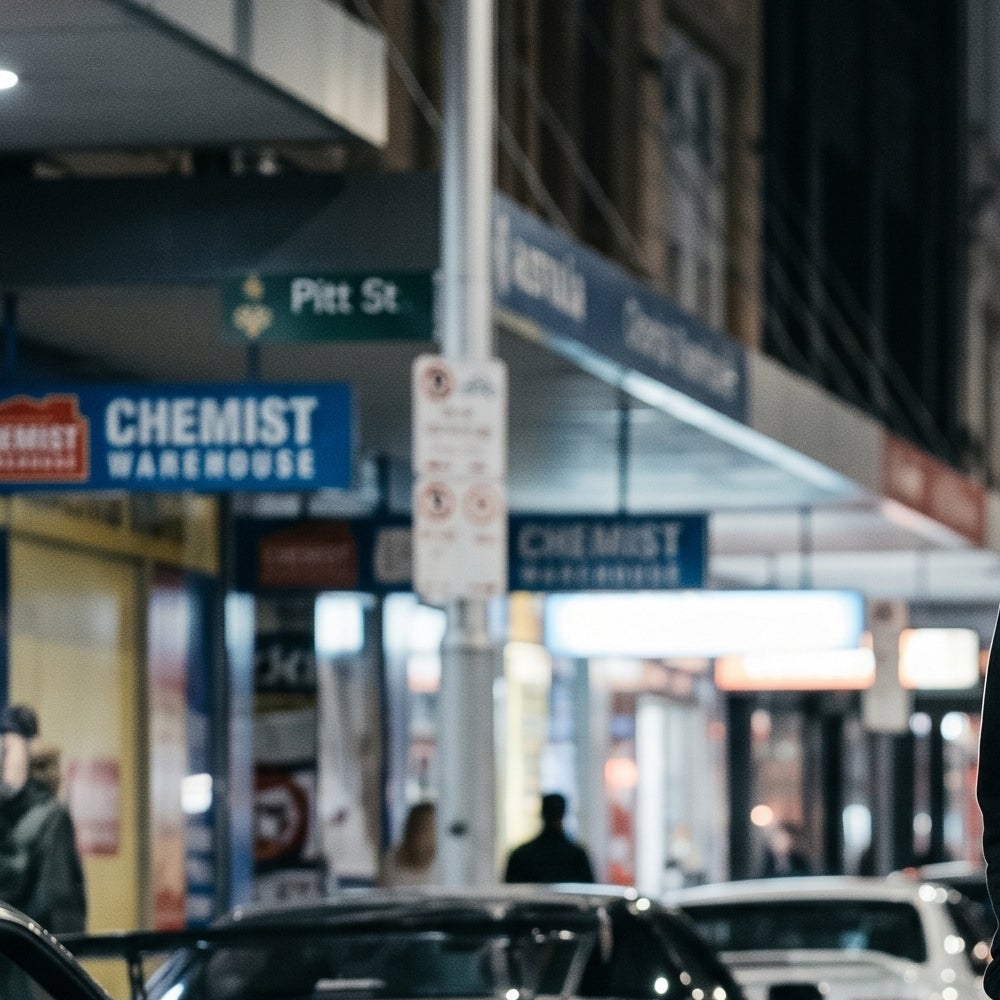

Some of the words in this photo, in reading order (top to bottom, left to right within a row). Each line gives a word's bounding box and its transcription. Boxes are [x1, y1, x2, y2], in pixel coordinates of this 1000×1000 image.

[290, 277, 350, 315] Pitt
[360, 277, 399, 315] St
[105, 396, 318, 448] CHEMIST
[106, 449, 314, 480] WAREHOUSE
